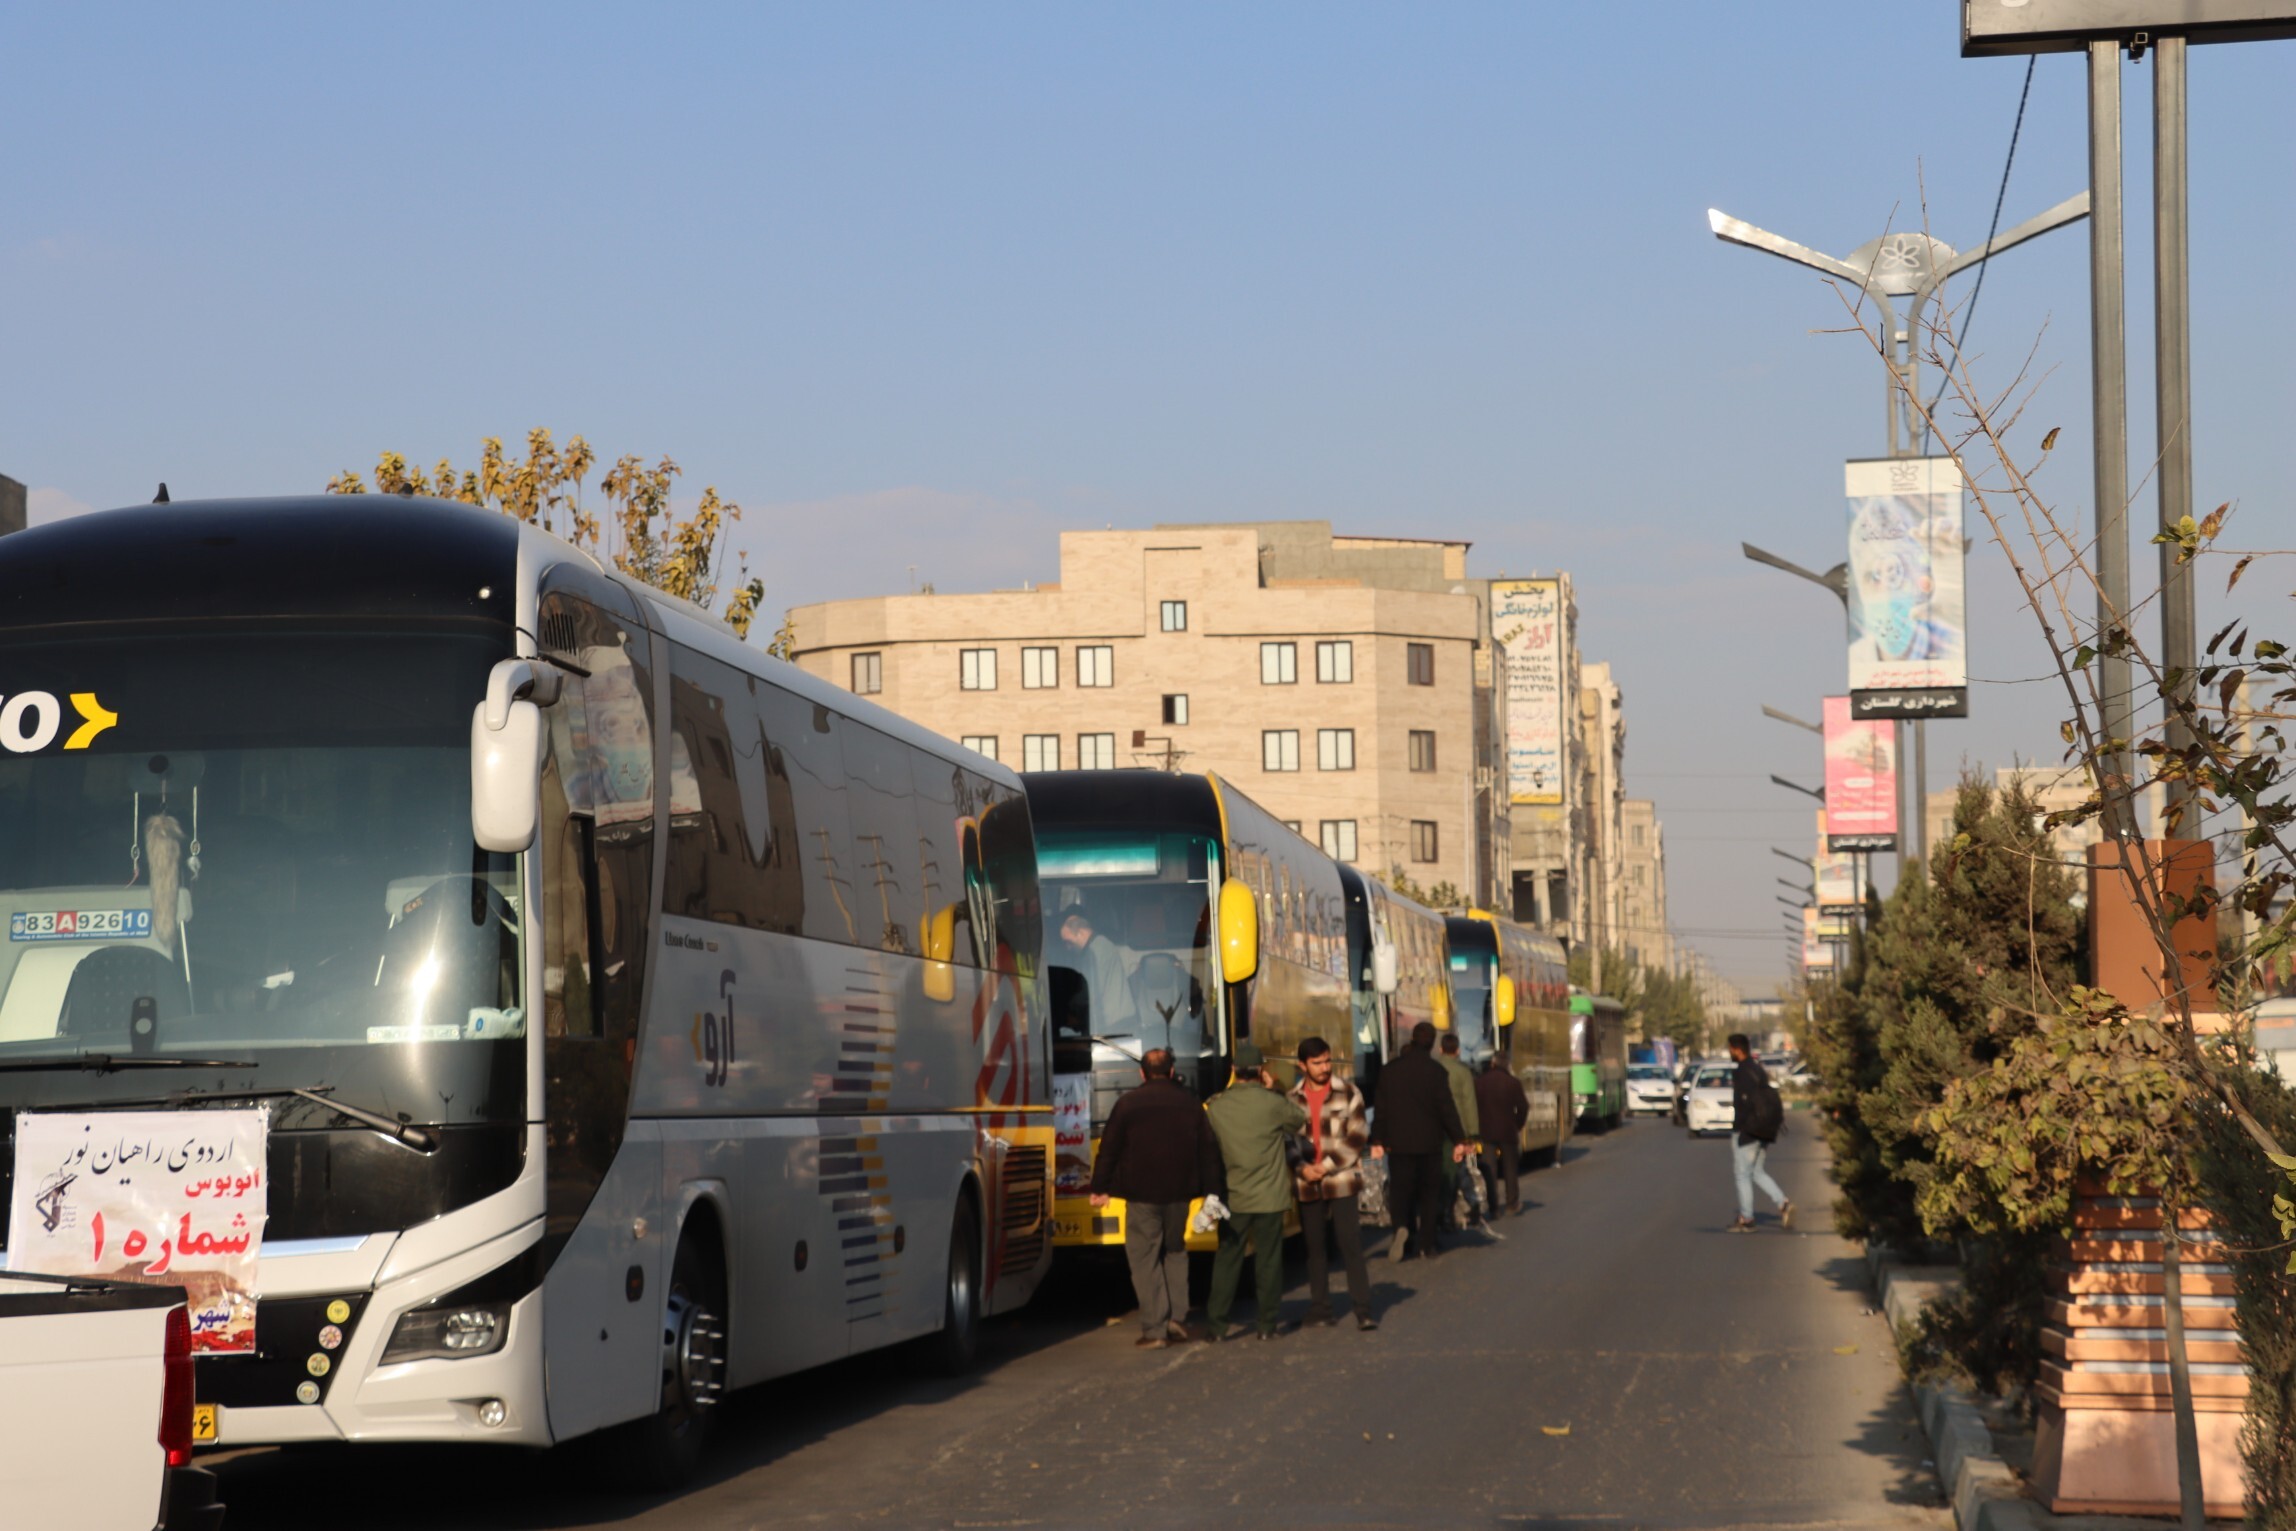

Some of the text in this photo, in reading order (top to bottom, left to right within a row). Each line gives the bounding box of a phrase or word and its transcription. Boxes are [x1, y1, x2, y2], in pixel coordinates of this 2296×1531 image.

[1860, 695, 1958, 711] شهرداری گلستان
[63, 1125, 235, 1186] اردوی راهیان نور
[185, 1168, 261, 1198] اتوبوس
[123, 1211, 252, 1275] شماره
[193, 1300, 231, 1332] شهر
